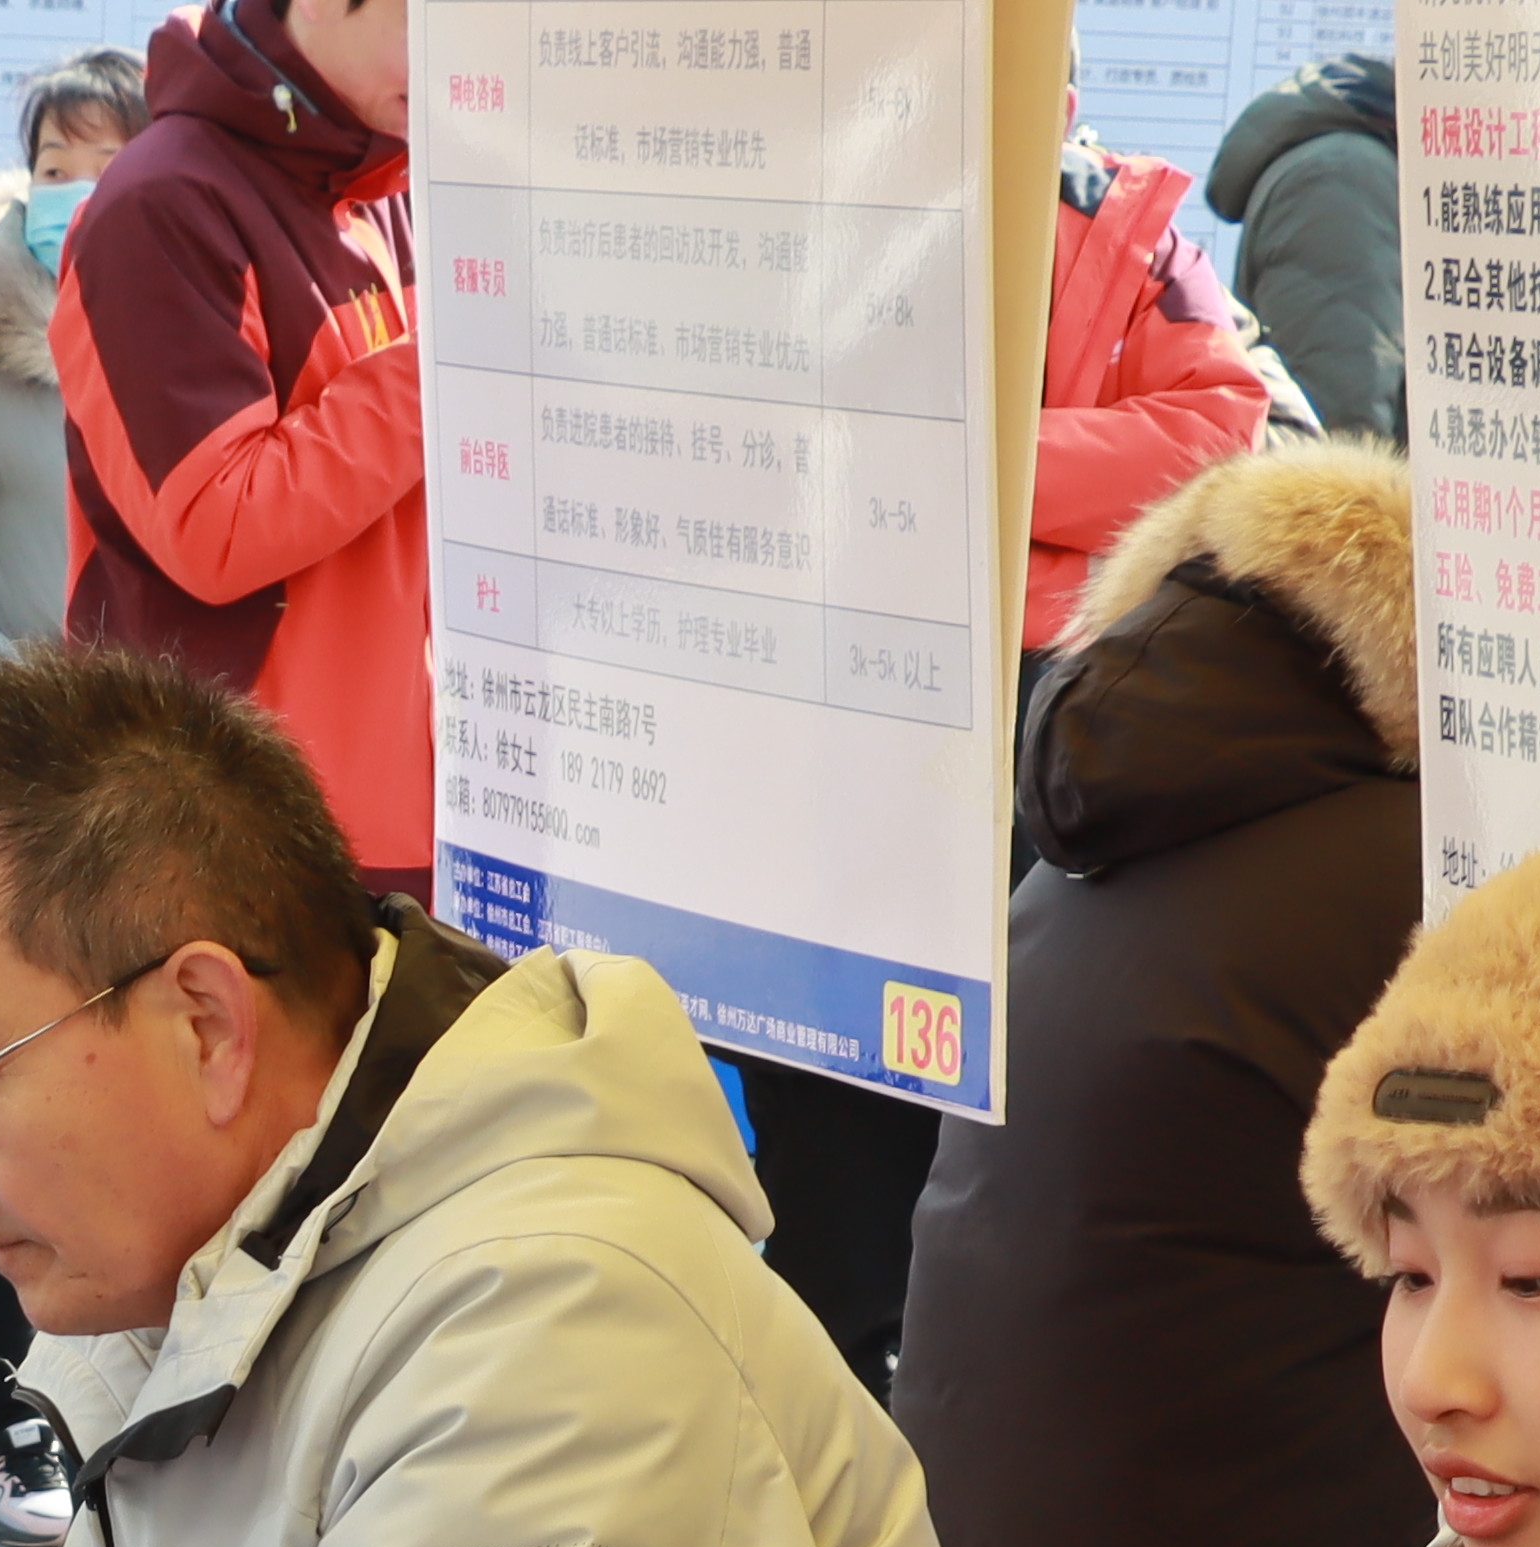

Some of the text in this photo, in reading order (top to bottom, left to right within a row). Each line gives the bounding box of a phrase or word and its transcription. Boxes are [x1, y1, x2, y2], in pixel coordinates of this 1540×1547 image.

[449, 74, 505, 113] 网电咨询
[452, 257, 507, 297] 客服专员
[458, 437, 510, 481] 前台导医
[476, 573, 501, 613] 护士
[889, 996, 960, 1078] 136
